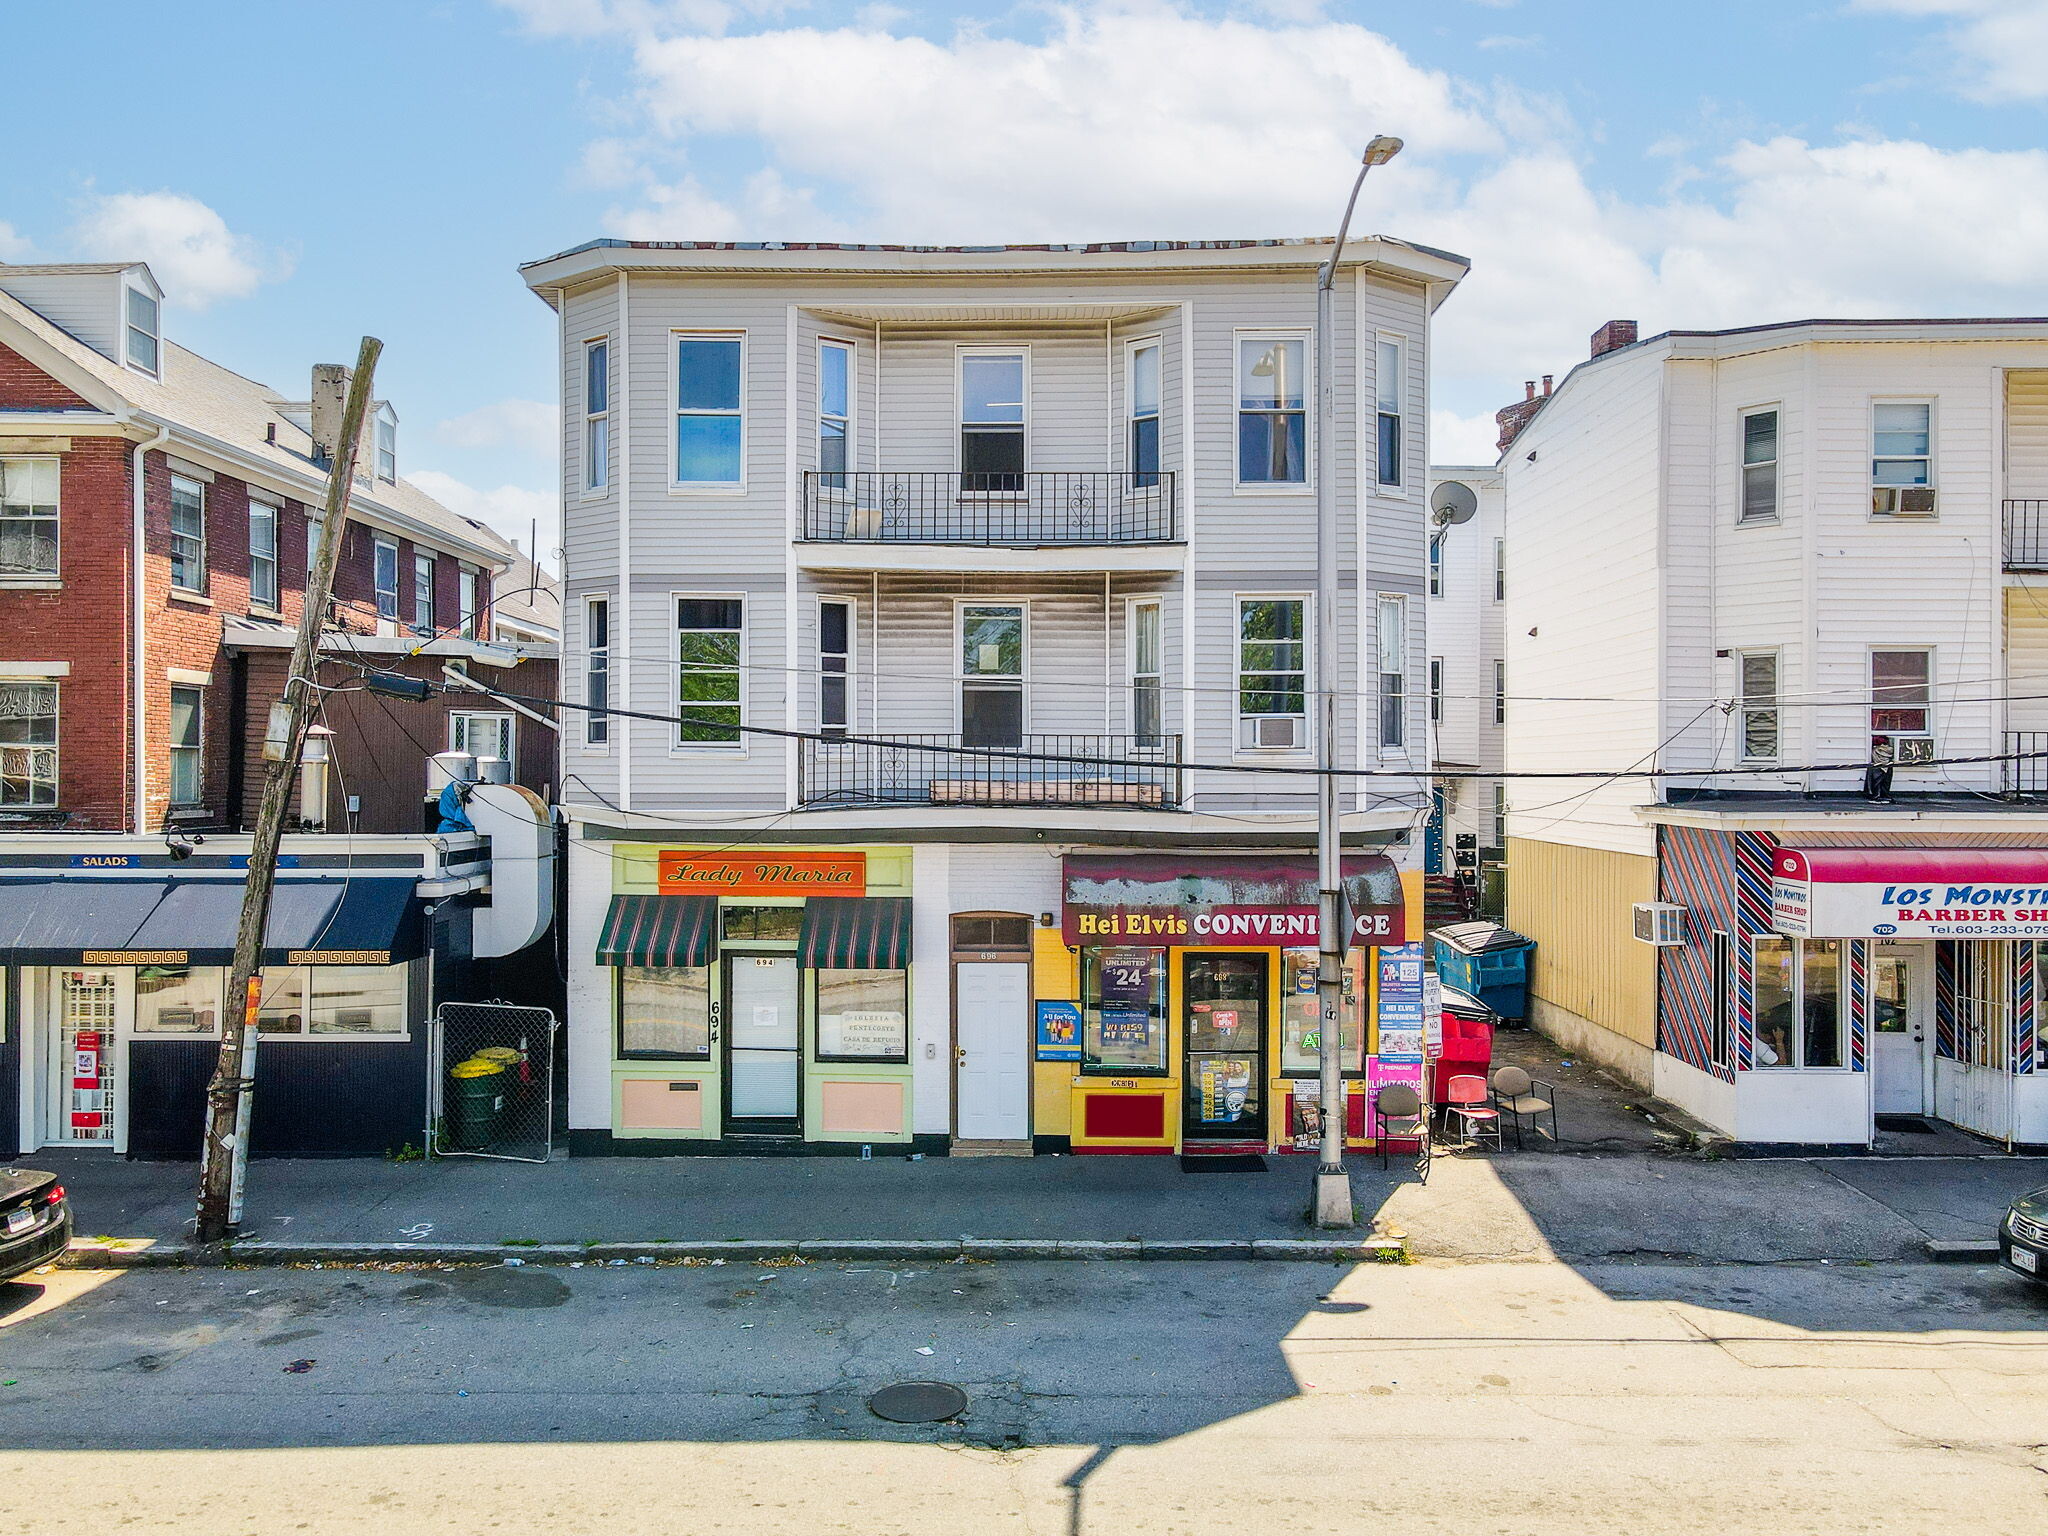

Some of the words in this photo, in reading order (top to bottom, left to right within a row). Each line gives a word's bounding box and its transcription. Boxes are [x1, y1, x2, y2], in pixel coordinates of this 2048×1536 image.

[82, 857, 128, 866] SALADS
[667, 864, 743, 885] Lady
[755, 864, 852, 883] Maria
[1881, 886, 1933, 905] LOS
[1775, 902, 1793, 914] BARBER
[1794, 906, 1807, 917] SHOP
[1897, 909, 2007, 922] BARBER
[2014, 909, 2048, 922] SH
[1078, 914, 1120, 934] Hei
[1125, 914, 1188, 934] Elvis
[1193, 914, 1391, 935] CONVENICE
[1876, 926, 1894, 934] 702
[710, 1001, 720, 1044] 694
